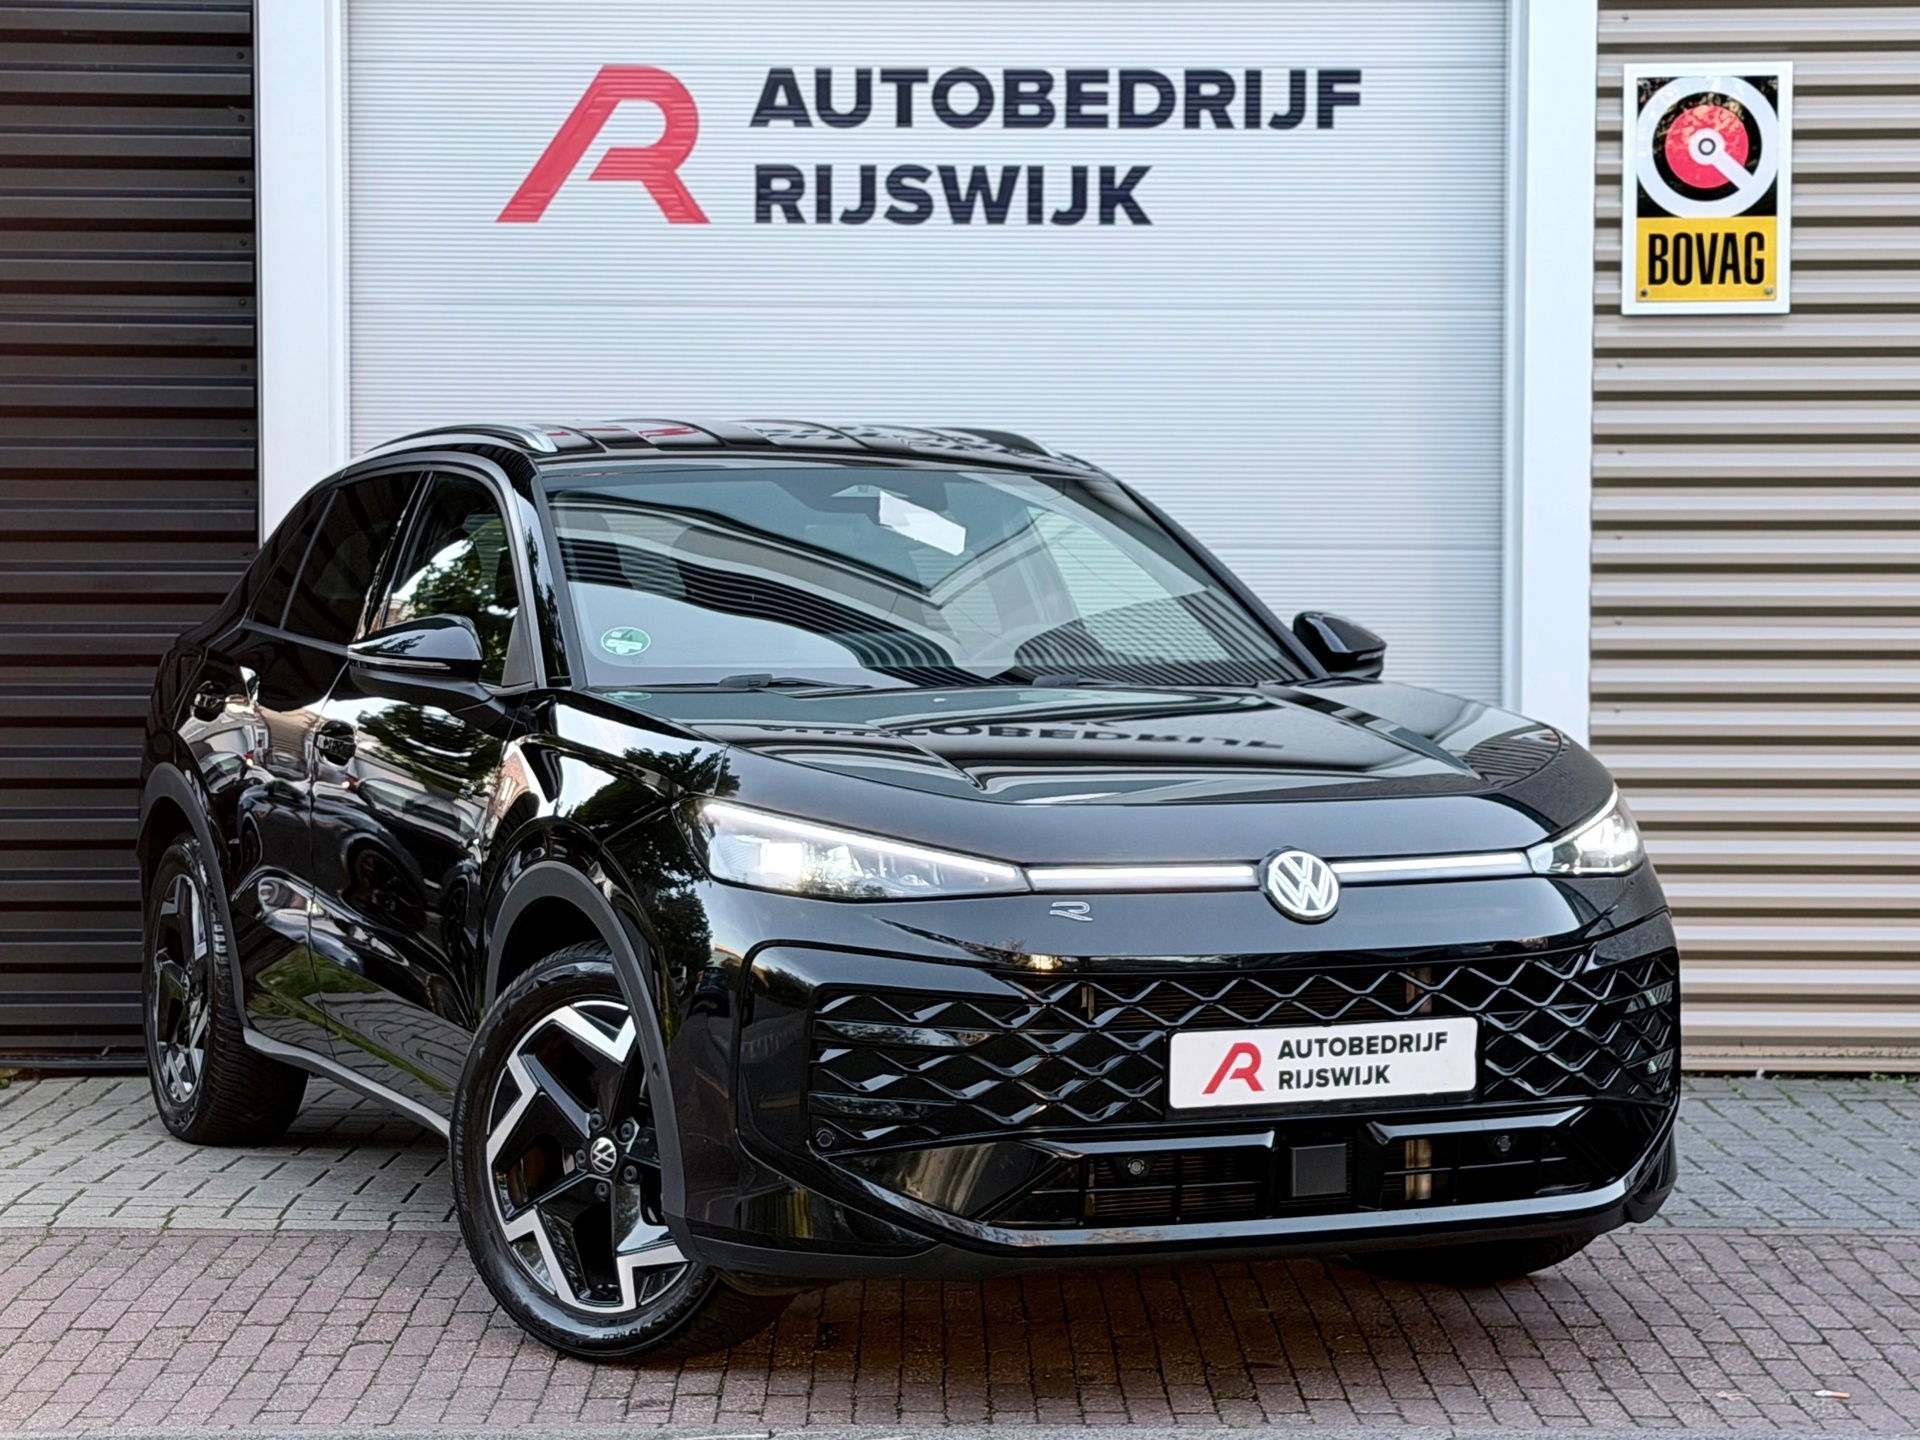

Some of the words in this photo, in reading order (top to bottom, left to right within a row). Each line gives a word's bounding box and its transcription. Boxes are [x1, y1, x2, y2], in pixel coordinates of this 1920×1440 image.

[750, 67, 1362, 130] AUTOBEDRIJF
[754, 164, 1153, 226] RIJSWIJK
[1647, 231, 1766, 287] BOVAG
[1277, 1031, 1449, 1060] AUTOBEDRIJF
[1278, 1064, 1391, 1090] RIJSWIJK
